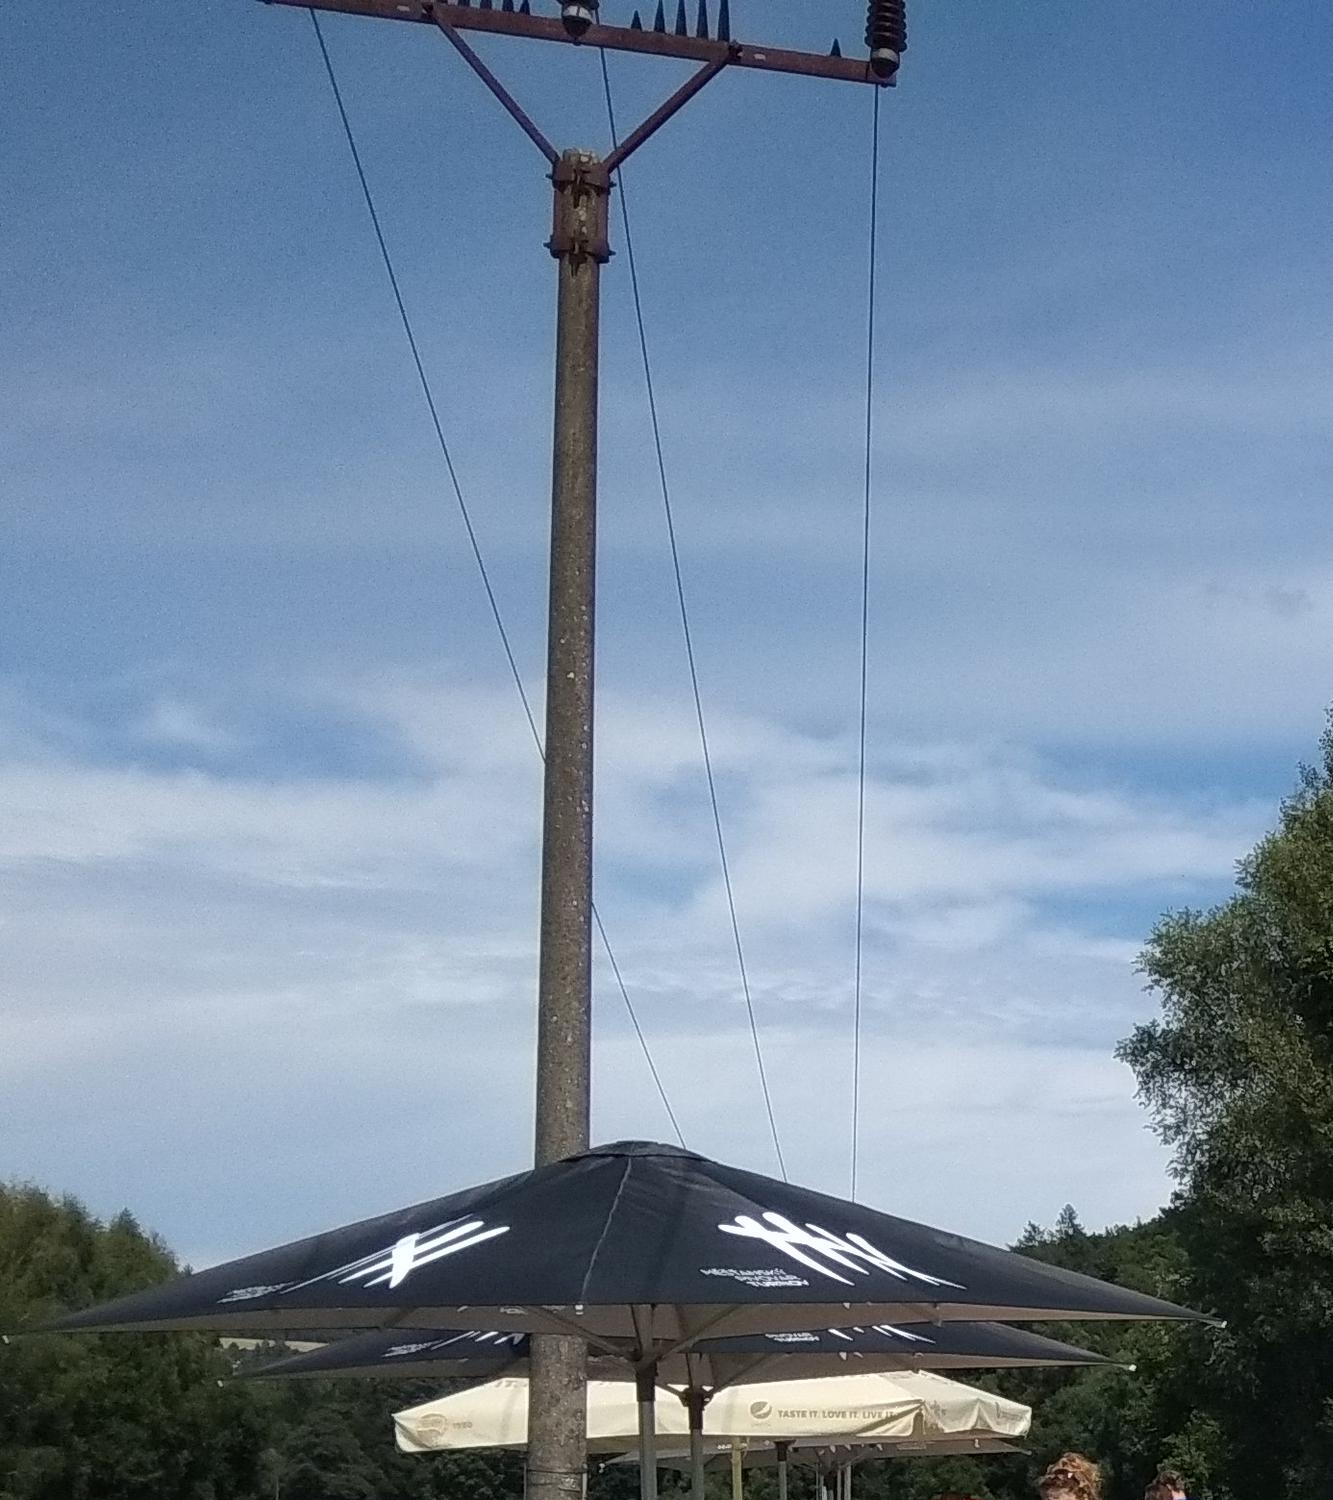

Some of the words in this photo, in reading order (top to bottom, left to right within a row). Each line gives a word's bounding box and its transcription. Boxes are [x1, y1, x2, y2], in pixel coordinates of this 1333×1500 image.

[778, 1409, 808, 1419] TASTE
[822, 1409, 847, 1419] LOVE
[862, 1411, 882, 1419] LIVE
